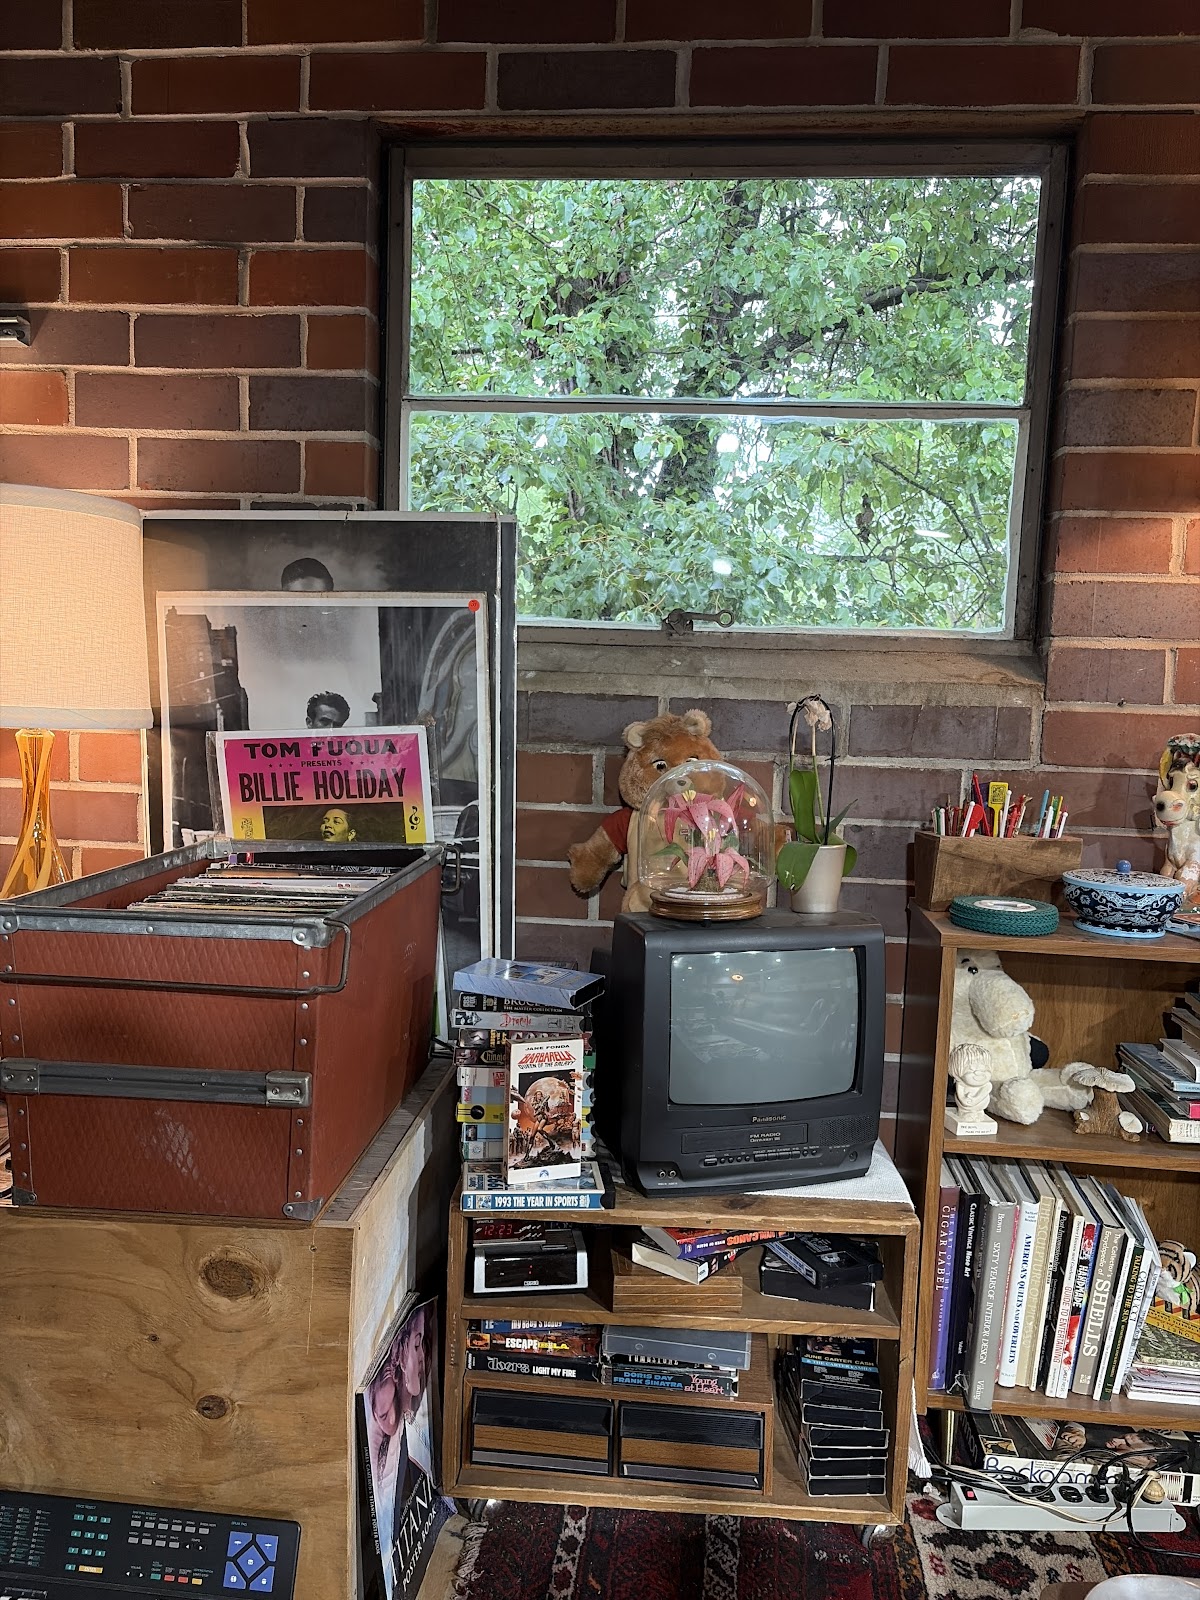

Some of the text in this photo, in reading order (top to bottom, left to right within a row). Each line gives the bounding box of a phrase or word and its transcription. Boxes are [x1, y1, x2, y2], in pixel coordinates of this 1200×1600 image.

[244, 738, 398, 759] TOM FUQUA
[301, 760, 342, 768] PRESENTS
[239, 768, 406, 802] BILLIE HOLIDAY
[518, 1050, 577, 1065] BARBARELLA
[495, 1197, 512, 1207] 1993
[513, 1196, 526, 1207] THE
[527, 1196, 544, 1207] YEAR
[545, 1196, 553, 1207] IN
[554, 1196, 578, 1207] SPORTS
[1040, 1200, 1051, 1222] THE
[484, 1224, 513, 1235] 12:23
[996, 1213, 1005, 1233] Brown
[936, 1205, 950, 1291] CIGAR LABEL
[1032, 1224, 1049, 1284] SCULPTURE
[1052, 1215, 1067, 1272] Post-Impressionism
[1098, 1231, 1112, 1277] Encyclopedia of
[946, 1255, 952, 1266] OF
[1020, 1234, 1032, 1279] AMERICA'S
[1106, 1246, 1119, 1278] Collector's
[1130, 1255, 1142, 1283] TALKING
[1016, 1281, 1026, 1308] QUILTS
[1028, 1288, 1039, 1303] OF
[1073, 1265, 1088, 1308] HANDMADE
[1128, 1285, 1135, 1293] TO
[1130, 1271, 1147, 1322] CARDUCCI
[979, 1242, 1001, 1365] SIXTY YEARS OF INTERIOR DESIGN
[1125, 1295, 1133, 1308] THE
[1053, 1286, 1072, 1364] GUIDE TO ENTERTAINING
[1082, 1279, 1111, 1357] SHELLS
[505, 1337, 538, 1349] ESCAPE
[1008, 1320, 1020, 1364] COVERLETS
[824, 1356, 852, 1364] CARTER
[532, 1366, 550, 1375] LIGHT
[551, 1368, 561, 1376] MY
[562, 1369, 577, 1378] FIRE
[613, 1376, 683, 1389] FRANK SINATRA
[623, 1371, 652, 1380] DORIS
[689, 1374, 718, 1389] Young
[695, 1384, 725, 1395] Heart
[974, 1380, 984, 1400] Viking
[390, 1472, 432, 1587] TITANI
[402, 1506, 437, 1592] POSTER BOOK
